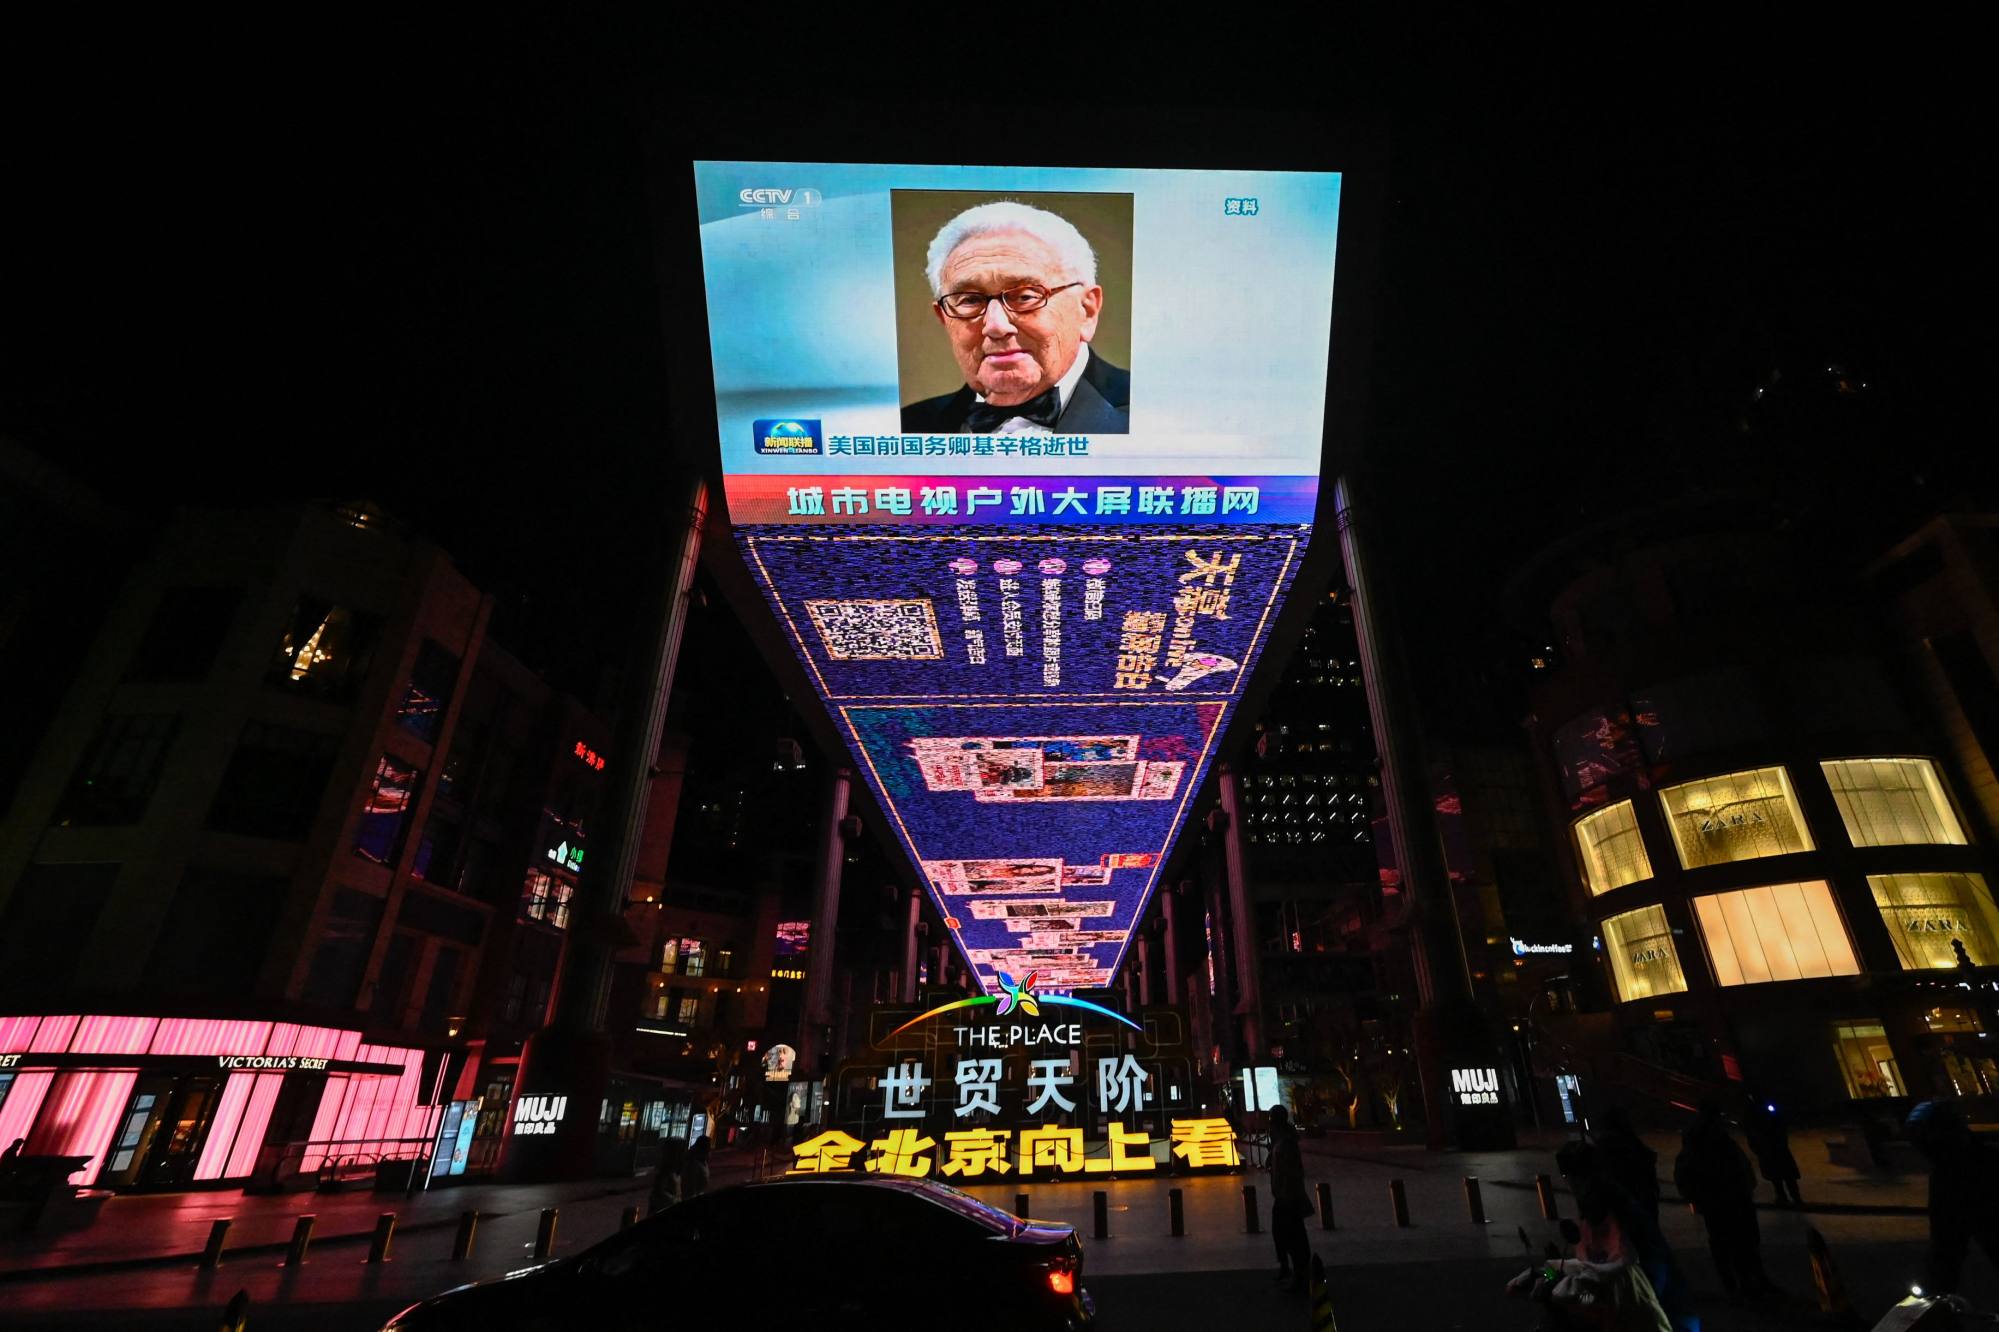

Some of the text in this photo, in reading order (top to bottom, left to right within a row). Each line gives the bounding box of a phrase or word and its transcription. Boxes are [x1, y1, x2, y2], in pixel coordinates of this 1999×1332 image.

[740, 188, 792, 204] CCTV
[1225, 198, 1259, 215] 资料
[764, 436, 813, 448] 新闻联播
[828, 435, 1089, 456] 美国前国务卿基辛格逝世
[787, 485, 1260, 516] 城市电视户外大屏联播网
[1701, 811, 1767, 833] ZARA
[1904, 918, 1968, 932] ZARA
[1632, 947, 1669, 963] ZARA
[953, 1023, 1081, 1047] THE PLACE
[219, 1056, 329, 1070] VICTORIA'S SECRET
[878, 1054, 1149, 1119] 世贸天阶
[1451, 1068, 1499, 1092] MUJI
[514, 1096, 567, 1122] MUJI
[786, 1118, 1240, 1178] 全北京向上看
